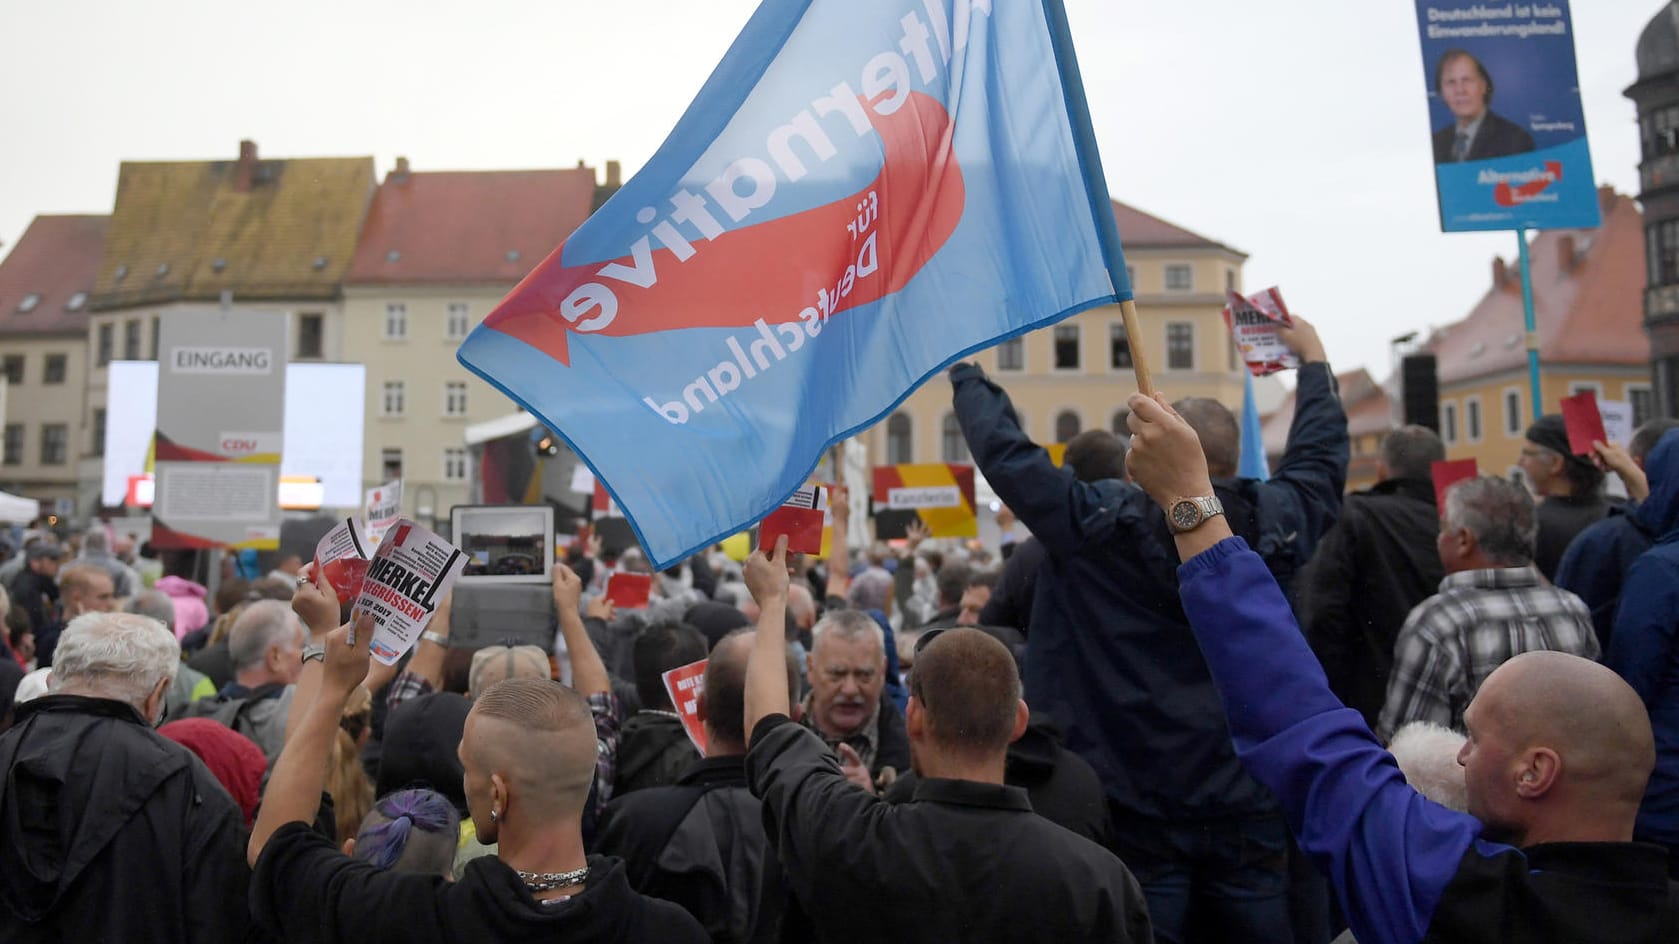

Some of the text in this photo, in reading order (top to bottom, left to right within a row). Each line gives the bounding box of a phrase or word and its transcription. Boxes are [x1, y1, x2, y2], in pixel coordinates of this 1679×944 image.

[1427, 3, 1561, 22] Deutschland ist kein
[176, 350, 269, 369] EINGANG
[222, 439, 258, 451] CDU
[366, 549, 459, 614] MERKEL
[373, 603, 392, 617] 2017
